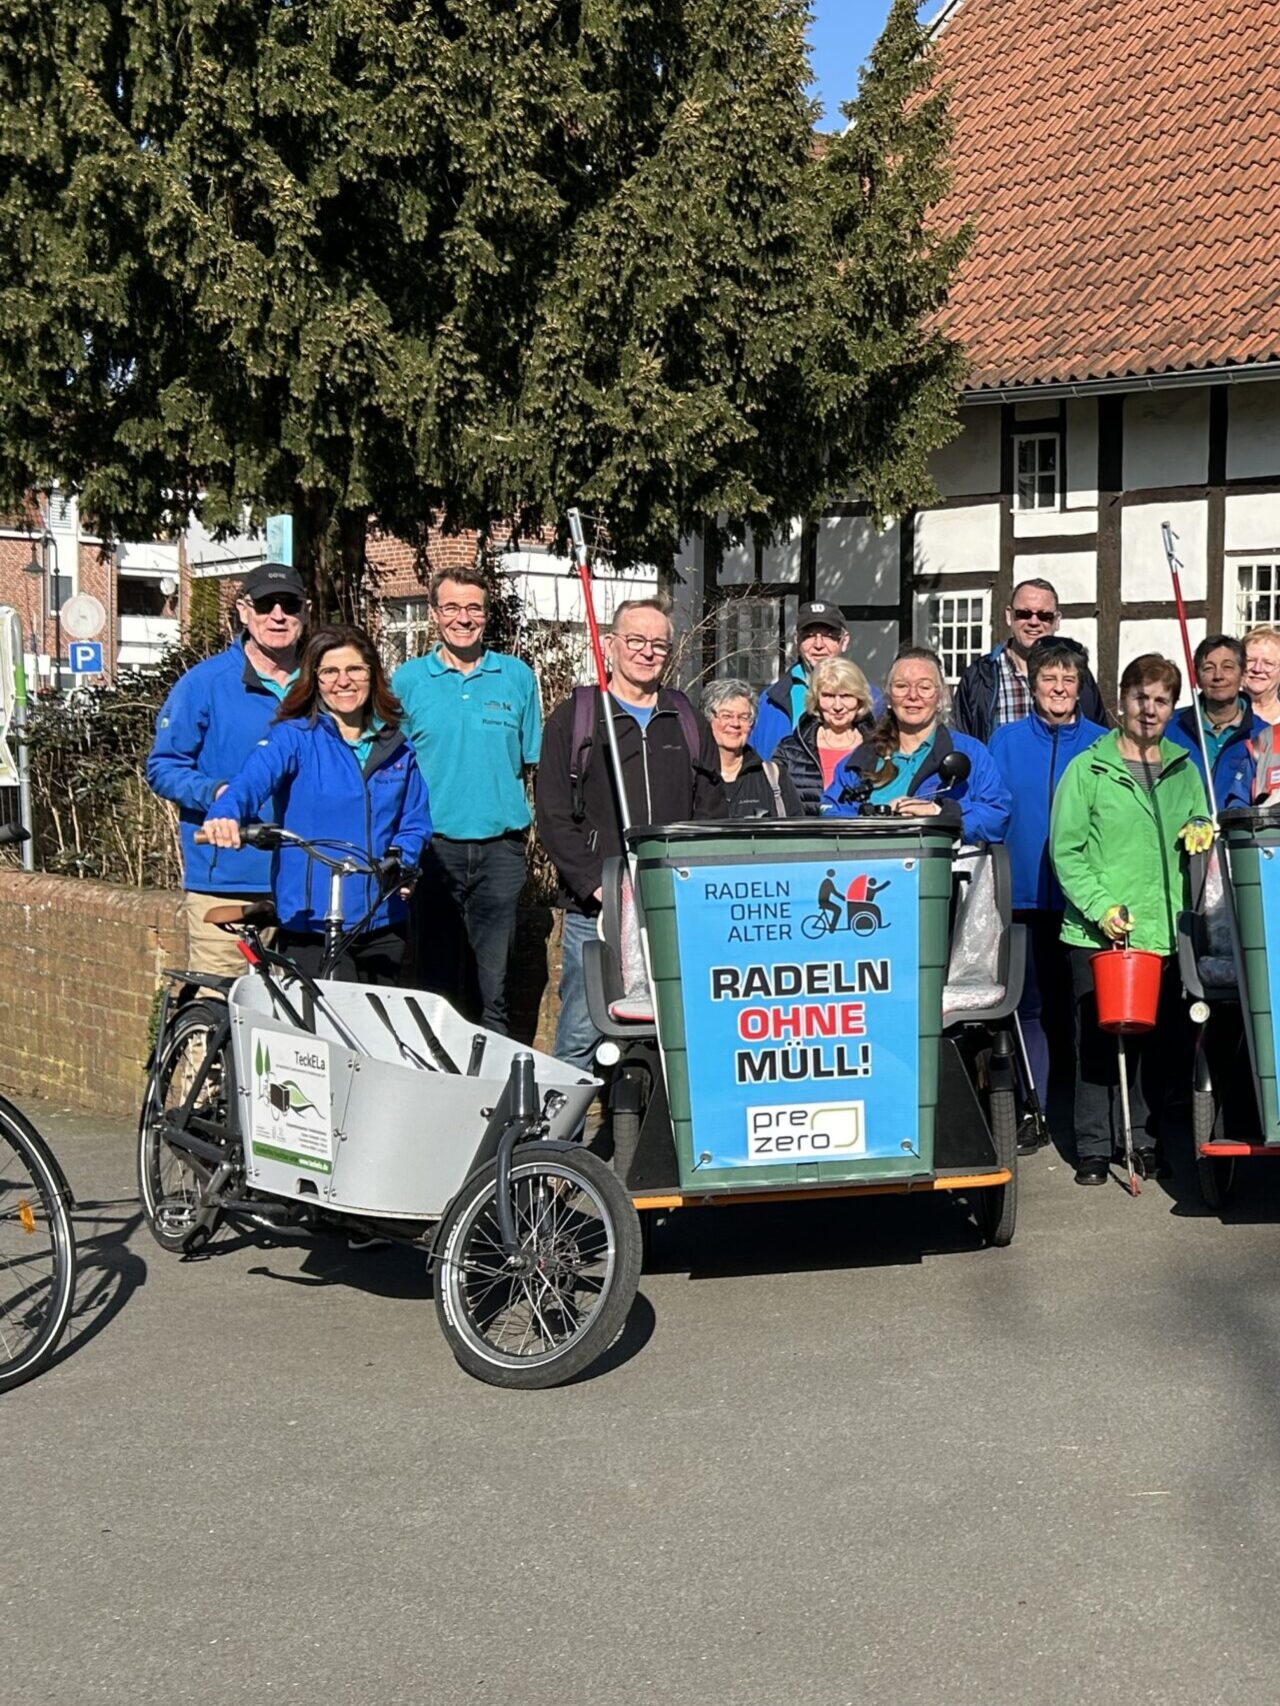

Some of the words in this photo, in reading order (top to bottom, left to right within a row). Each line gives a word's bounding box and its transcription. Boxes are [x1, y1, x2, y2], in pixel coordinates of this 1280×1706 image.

[76, 646, 95, 670] P
[705, 880, 791, 900] RADELN
[730, 902, 792, 921] OHNE
[727, 924, 792, 943] ALTER
[712, 960, 890, 1000] RADELN
[739, 1003, 865, 1040] OHNE
[294, 1050, 326, 1071] TeckELa
[737, 1041, 871, 1083] MÜLL!
[753, 1109, 809, 1134] pre
[754, 1133, 831, 1154] zero
